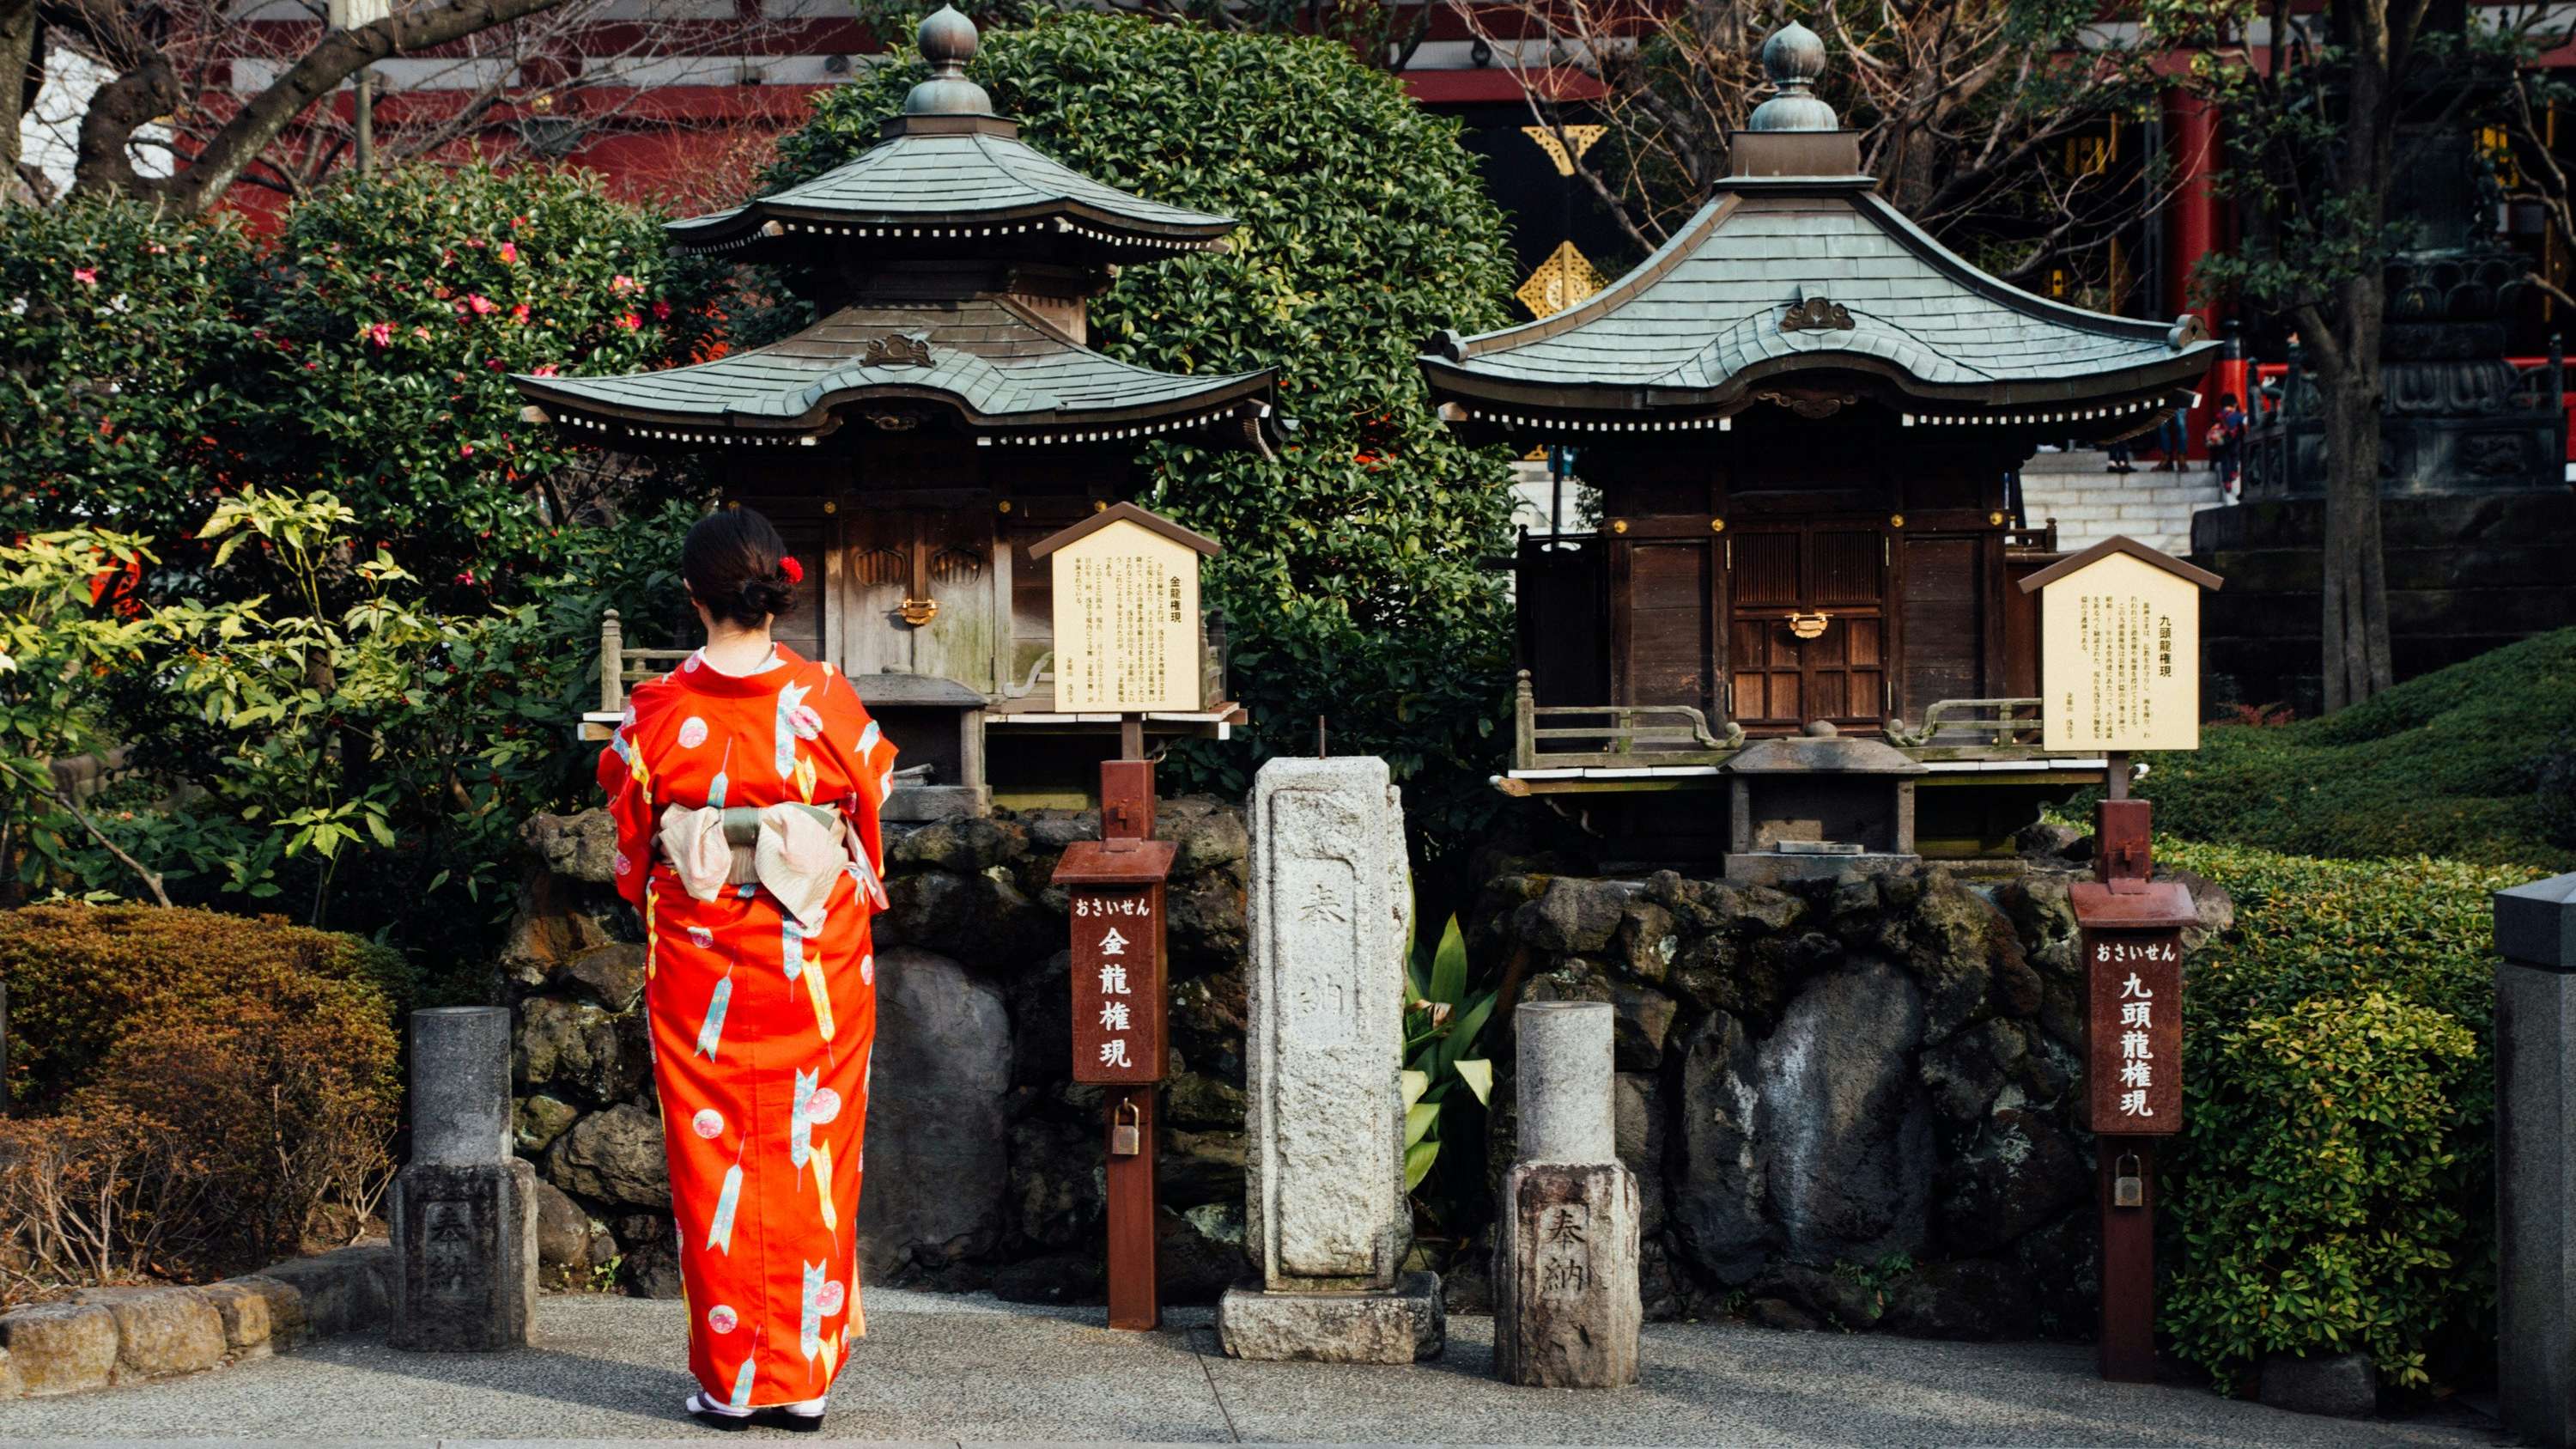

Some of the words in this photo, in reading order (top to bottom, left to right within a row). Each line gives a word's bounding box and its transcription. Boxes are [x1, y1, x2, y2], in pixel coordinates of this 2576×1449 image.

[1170, 575, 1182, 624] 金龍権現
[2159, 614, 2172, 678] 九頭龍権現
[1075, 898, 1151, 917] おさいせん
[1297, 884, 1346, 1015] 奉納
[2097, 943, 2176, 963] おさいせん
[1098, 927, 1133, 1068] 金龍権現
[2119, 972, 2154, 1117] 九頭龍権現
[1545, 1209, 1586, 1292] 奉納
